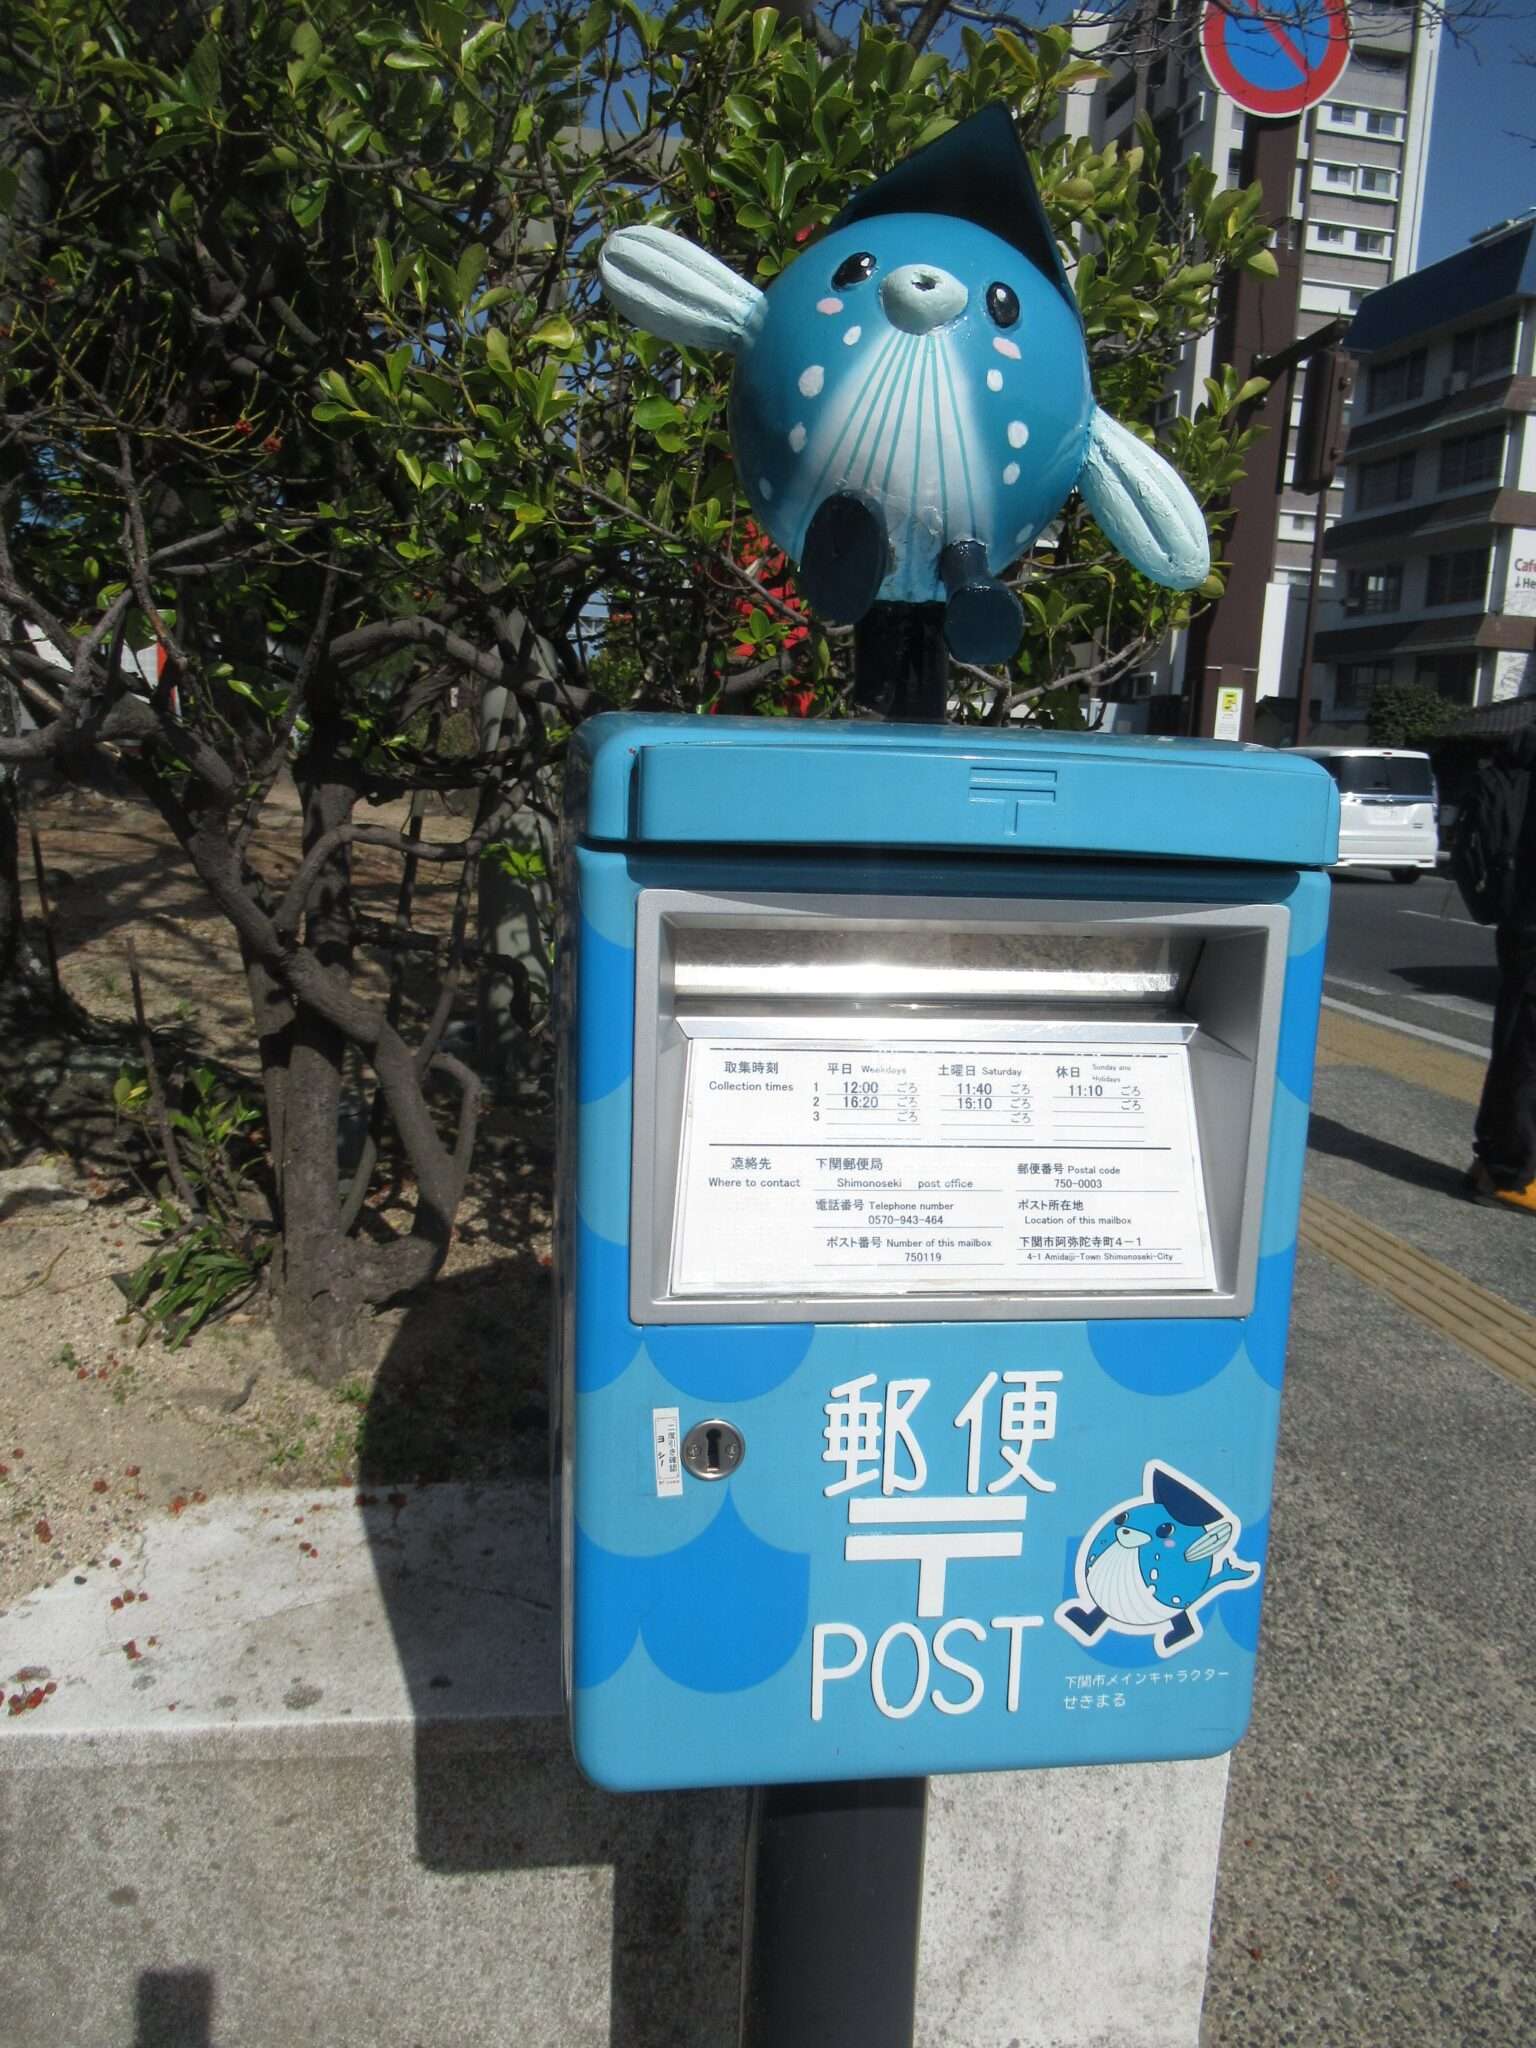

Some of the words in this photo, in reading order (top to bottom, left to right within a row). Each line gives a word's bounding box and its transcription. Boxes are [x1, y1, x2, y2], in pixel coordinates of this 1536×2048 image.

[724, 1061, 779, 1074] 取集時刻
[827, 1063, 852, 1075] 平日
[938, 1065, 976, 1077] 土曜日
[982, 1066, 1022, 1077] Saturday
[1056, 1066, 1081, 1078] 休日
[709, 1081, 762, 1092] Collection
[765, 1082, 794, 1092] times
[813, 1083, 819, 1092] 1
[843, 1082, 879, 1093] 12:00
[897, 1082, 919, 1093] ごろ
[957, 1083, 993, 1095] 11:40
[1010, 1083, 1031, 1095] ごろ
[1069, 1085, 1103, 1097] 11:10
[1120, 1085, 1141, 1097] ごろ
[812, 1097, 820, 1107] 2
[843, 1096, 879, 1108] 16:20
[897, 1097, 919, 1108] ごろ
[1010, 1098, 1031, 1109] ごろ
[1121, 1100, 1142, 1111] ごろ
[812, 1111, 820, 1122] 3
[897, 1111, 919, 1122] ごろ
[1010, 1112, 1031, 1124] ごろ
[815, 1158, 883, 1171] 下関郵便局
[1017, 1163, 1064, 1175] 郵便番号
[1068, 1165, 1096, 1175] Postal
[1099, 1166, 1121, 1175] code
[709, 1177, 743, 1188] Where
[745, 1178, 757, 1188] to
[760, 1178, 801, 1188] contact
[837, 1177, 902, 1188] Shimonoseki
[918, 1179, 941, 1190] post
[944, 1179, 974, 1189] office
[1055, 1178, 1103, 1189] 750-0003
[815, 1199, 865, 1211] 電話番号
[869, 1201, 917, 1212] Telephone
[919, 1202, 954, 1211] number
[1018, 1200, 1084, 1212] ポスト所在地
[868, 1214, 944, 1225] 0570-943-464
[1024, 1215, 1064, 1225] Location
[1067, 1216, 1077, 1225] of
[1079, 1216, 1096, 1225] this
[1098, 1216, 1132, 1225] mailbox
[826, 1236, 882, 1249] ポスト番号
[886, 1238, 922, 1248] Number
[925, 1238, 936, 1248] of
[938, 1238, 955, 1248] this
[958, 1238, 992, 1248] mailbox
[904, 1252, 942, 1262] 750119
[1027, 1253, 1041, 1261] 4-1
[822, 1370, 1064, 1497] 郵便
[811, 1615, 1045, 1721] POST
[1065, 1668, 1230, 1689] 下関市メインキャラクター
[1064, 1692, 1127, 1710] せきまる
